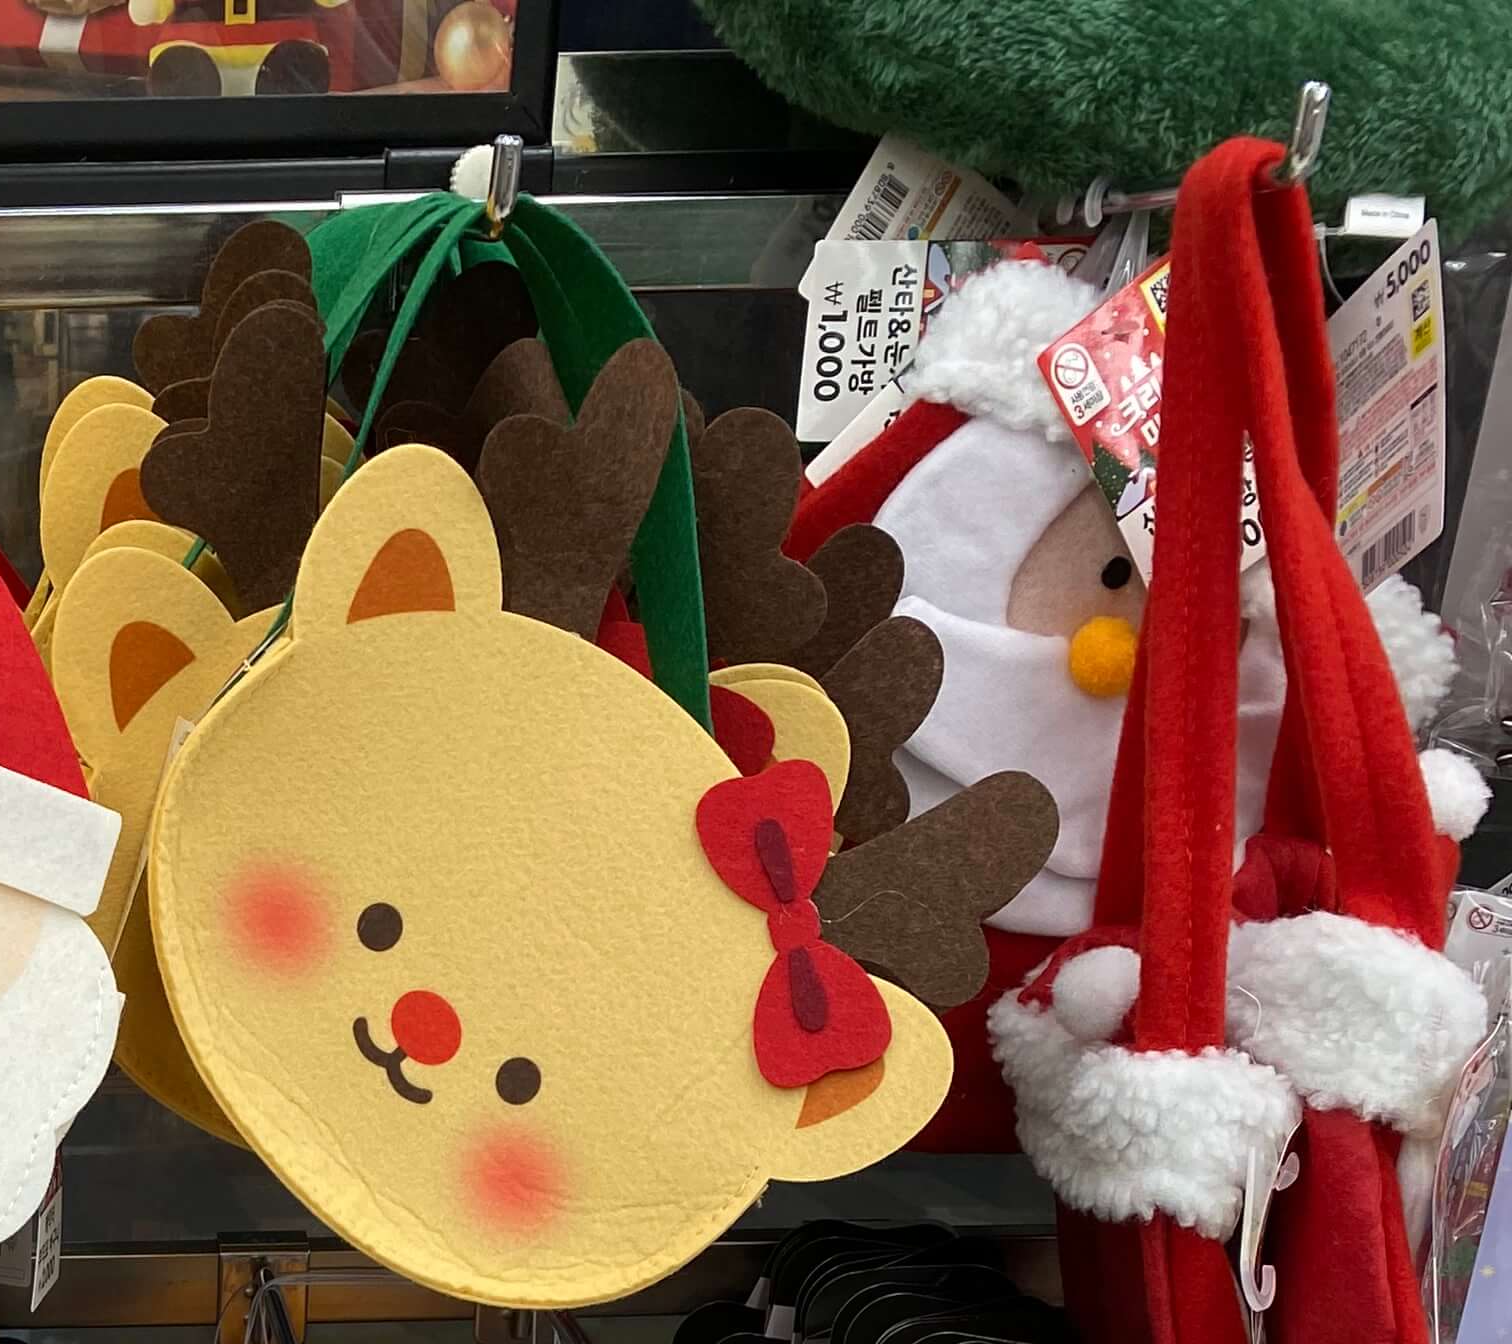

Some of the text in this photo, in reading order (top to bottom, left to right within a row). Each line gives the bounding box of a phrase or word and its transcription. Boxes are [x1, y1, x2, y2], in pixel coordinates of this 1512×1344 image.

[813, 281, 849, 402] ₩1,000
[848, 288, 883, 396] 펠트가방
[1112, 373, 1160, 437] 크리
